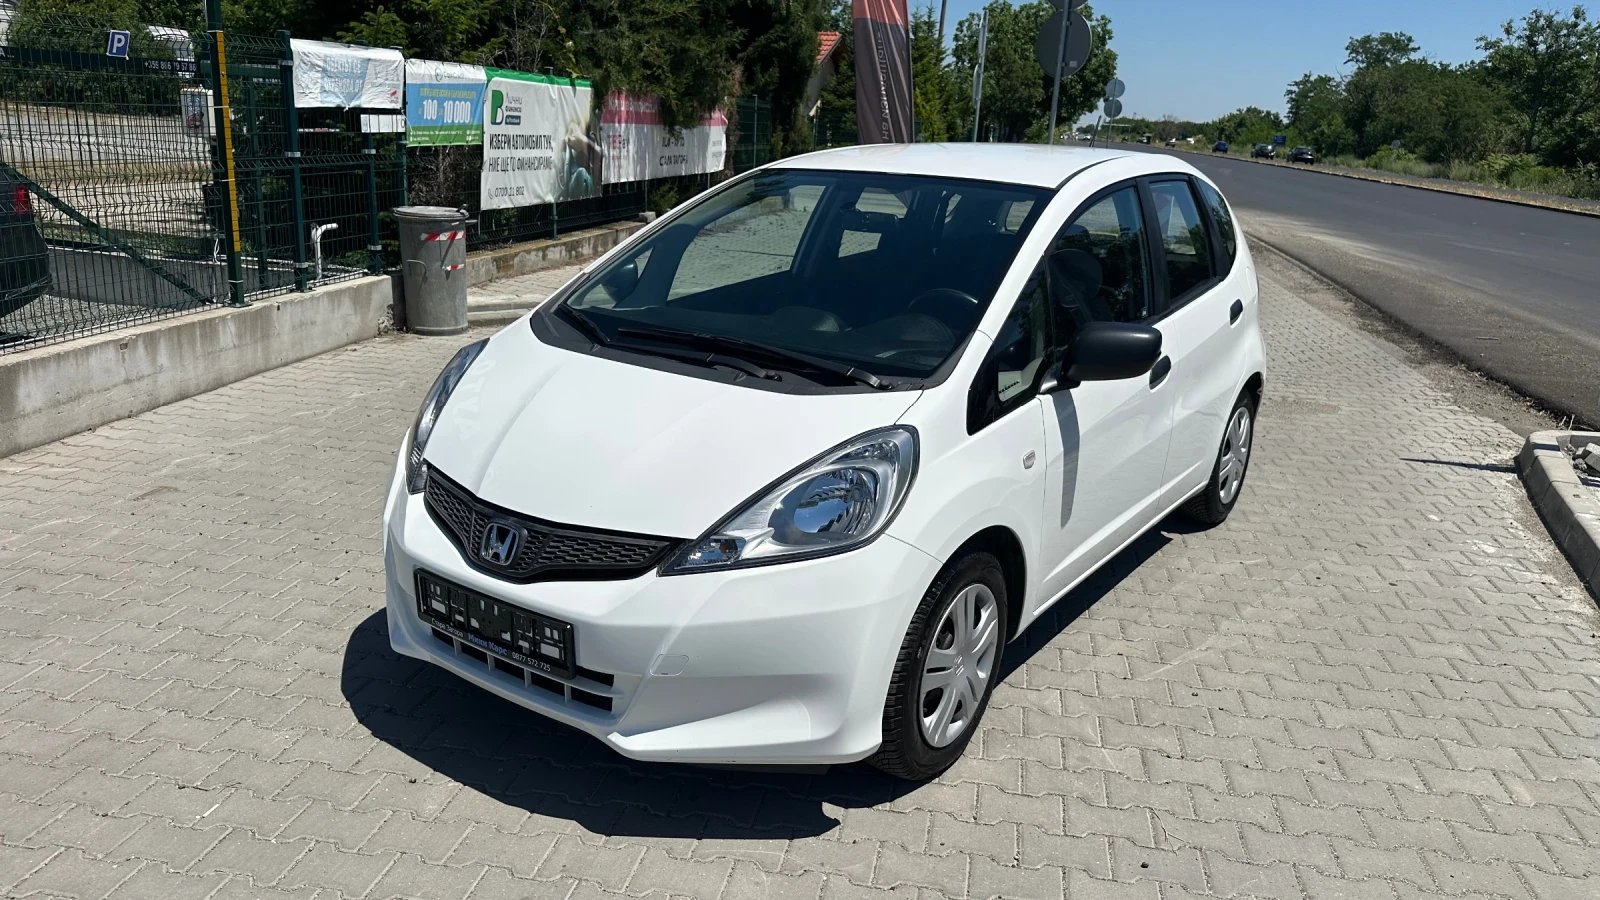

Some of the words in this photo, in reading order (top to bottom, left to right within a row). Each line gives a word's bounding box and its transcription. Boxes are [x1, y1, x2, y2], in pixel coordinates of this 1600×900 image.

[112, 34, 125, 53] P
[505, 92, 523, 105] Лични
[422, 99, 438, 120] 100
[489, 133, 511, 150] ИЗБЕРИ
[512, 134, 543, 150] АВТОМОБИЛ
[488, 157, 500, 172] НИЕ
[500, 157, 509, 174] ЩЕ
[509, 156, 516, 172] ГО
[516, 156, 553, 172] ФИНАНСИРАМЕ
[659, 154, 673, 167] САРА
[494, 187, 508, 198] 0700
[508, 187, 515, 197] 11
[515, 186, 525, 196] 802
[431, 617, 446, 630] Стара
[446, 624, 464, 638] Загора
[488, 641, 508, 656] Карс
[511, 651, 526, 663] 0877
[527, 657, 539, 668] 572
[539, 661, 551, 672] 725
